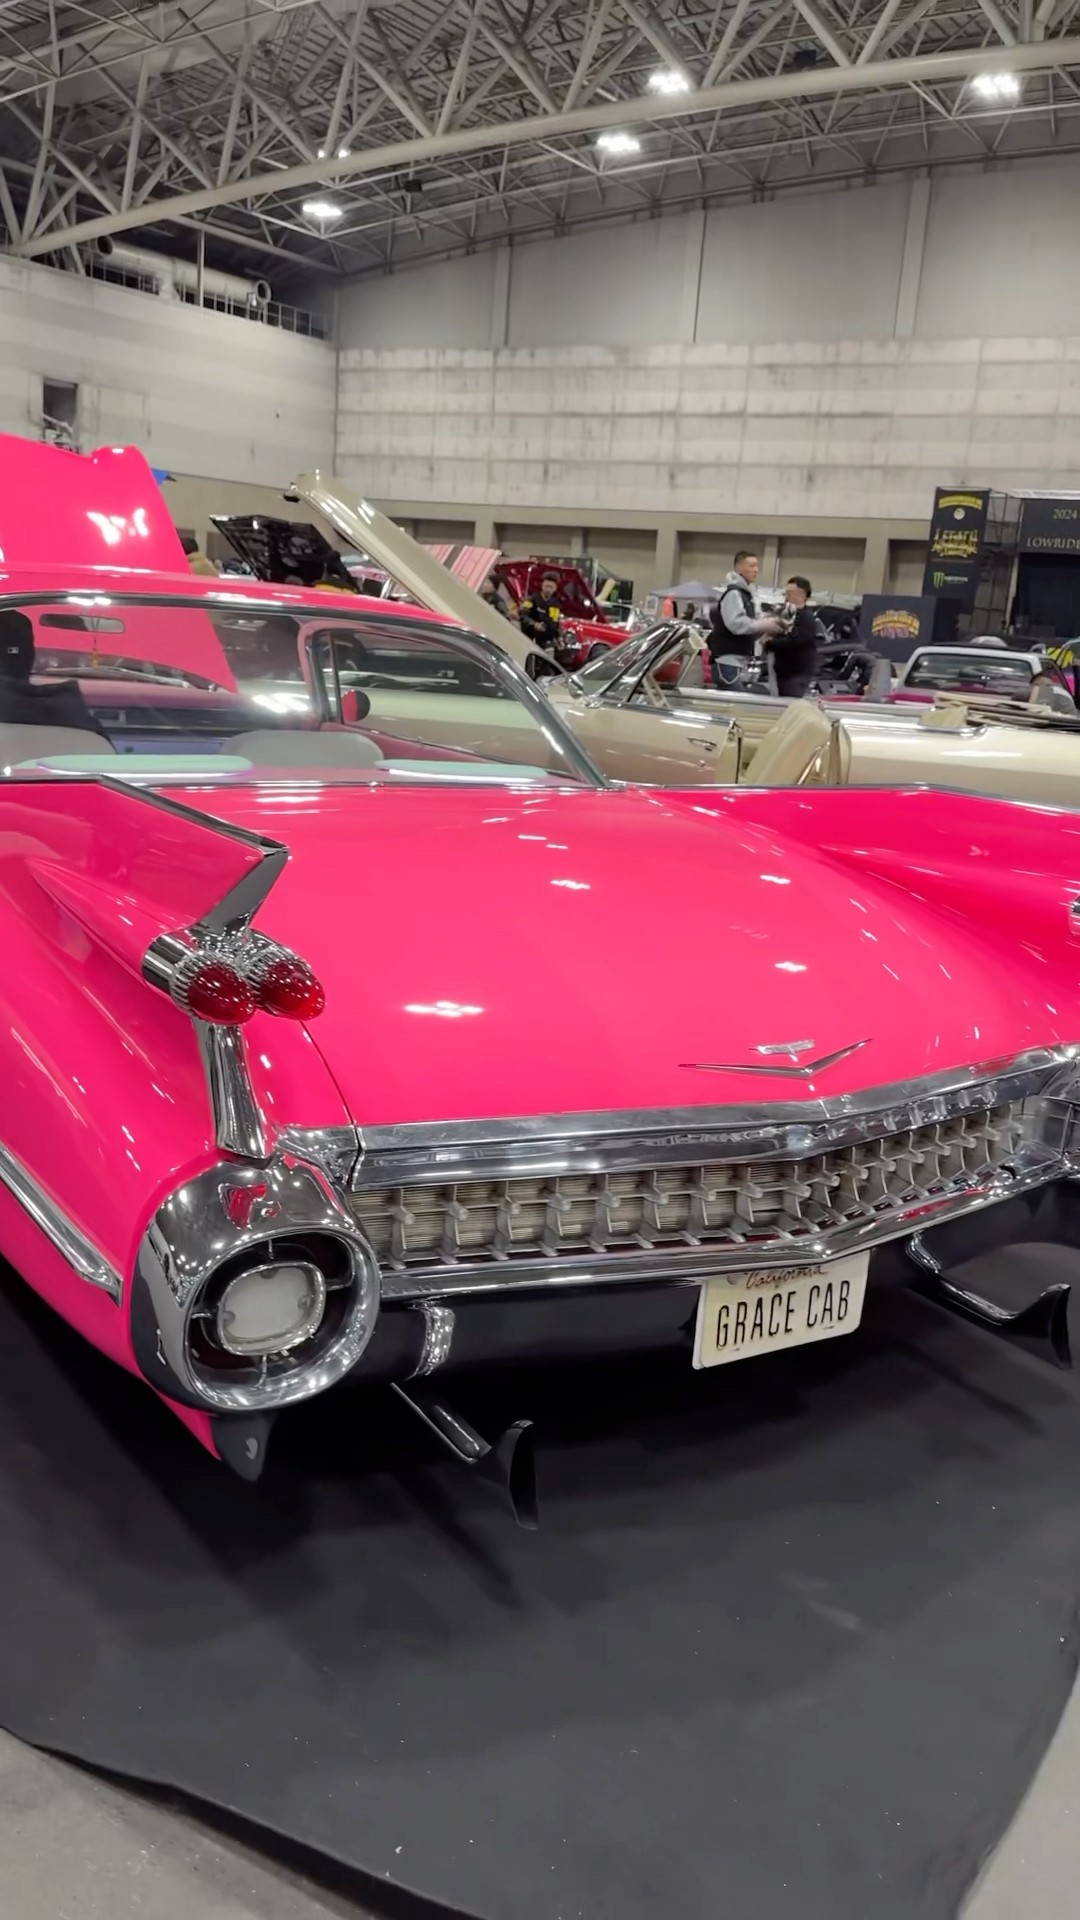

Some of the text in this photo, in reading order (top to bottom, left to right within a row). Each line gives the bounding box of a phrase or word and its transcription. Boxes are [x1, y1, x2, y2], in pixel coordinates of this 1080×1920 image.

[1053, 508, 1077, 520] 2024
[716, 1280, 851, 1349] GRACE CAB
